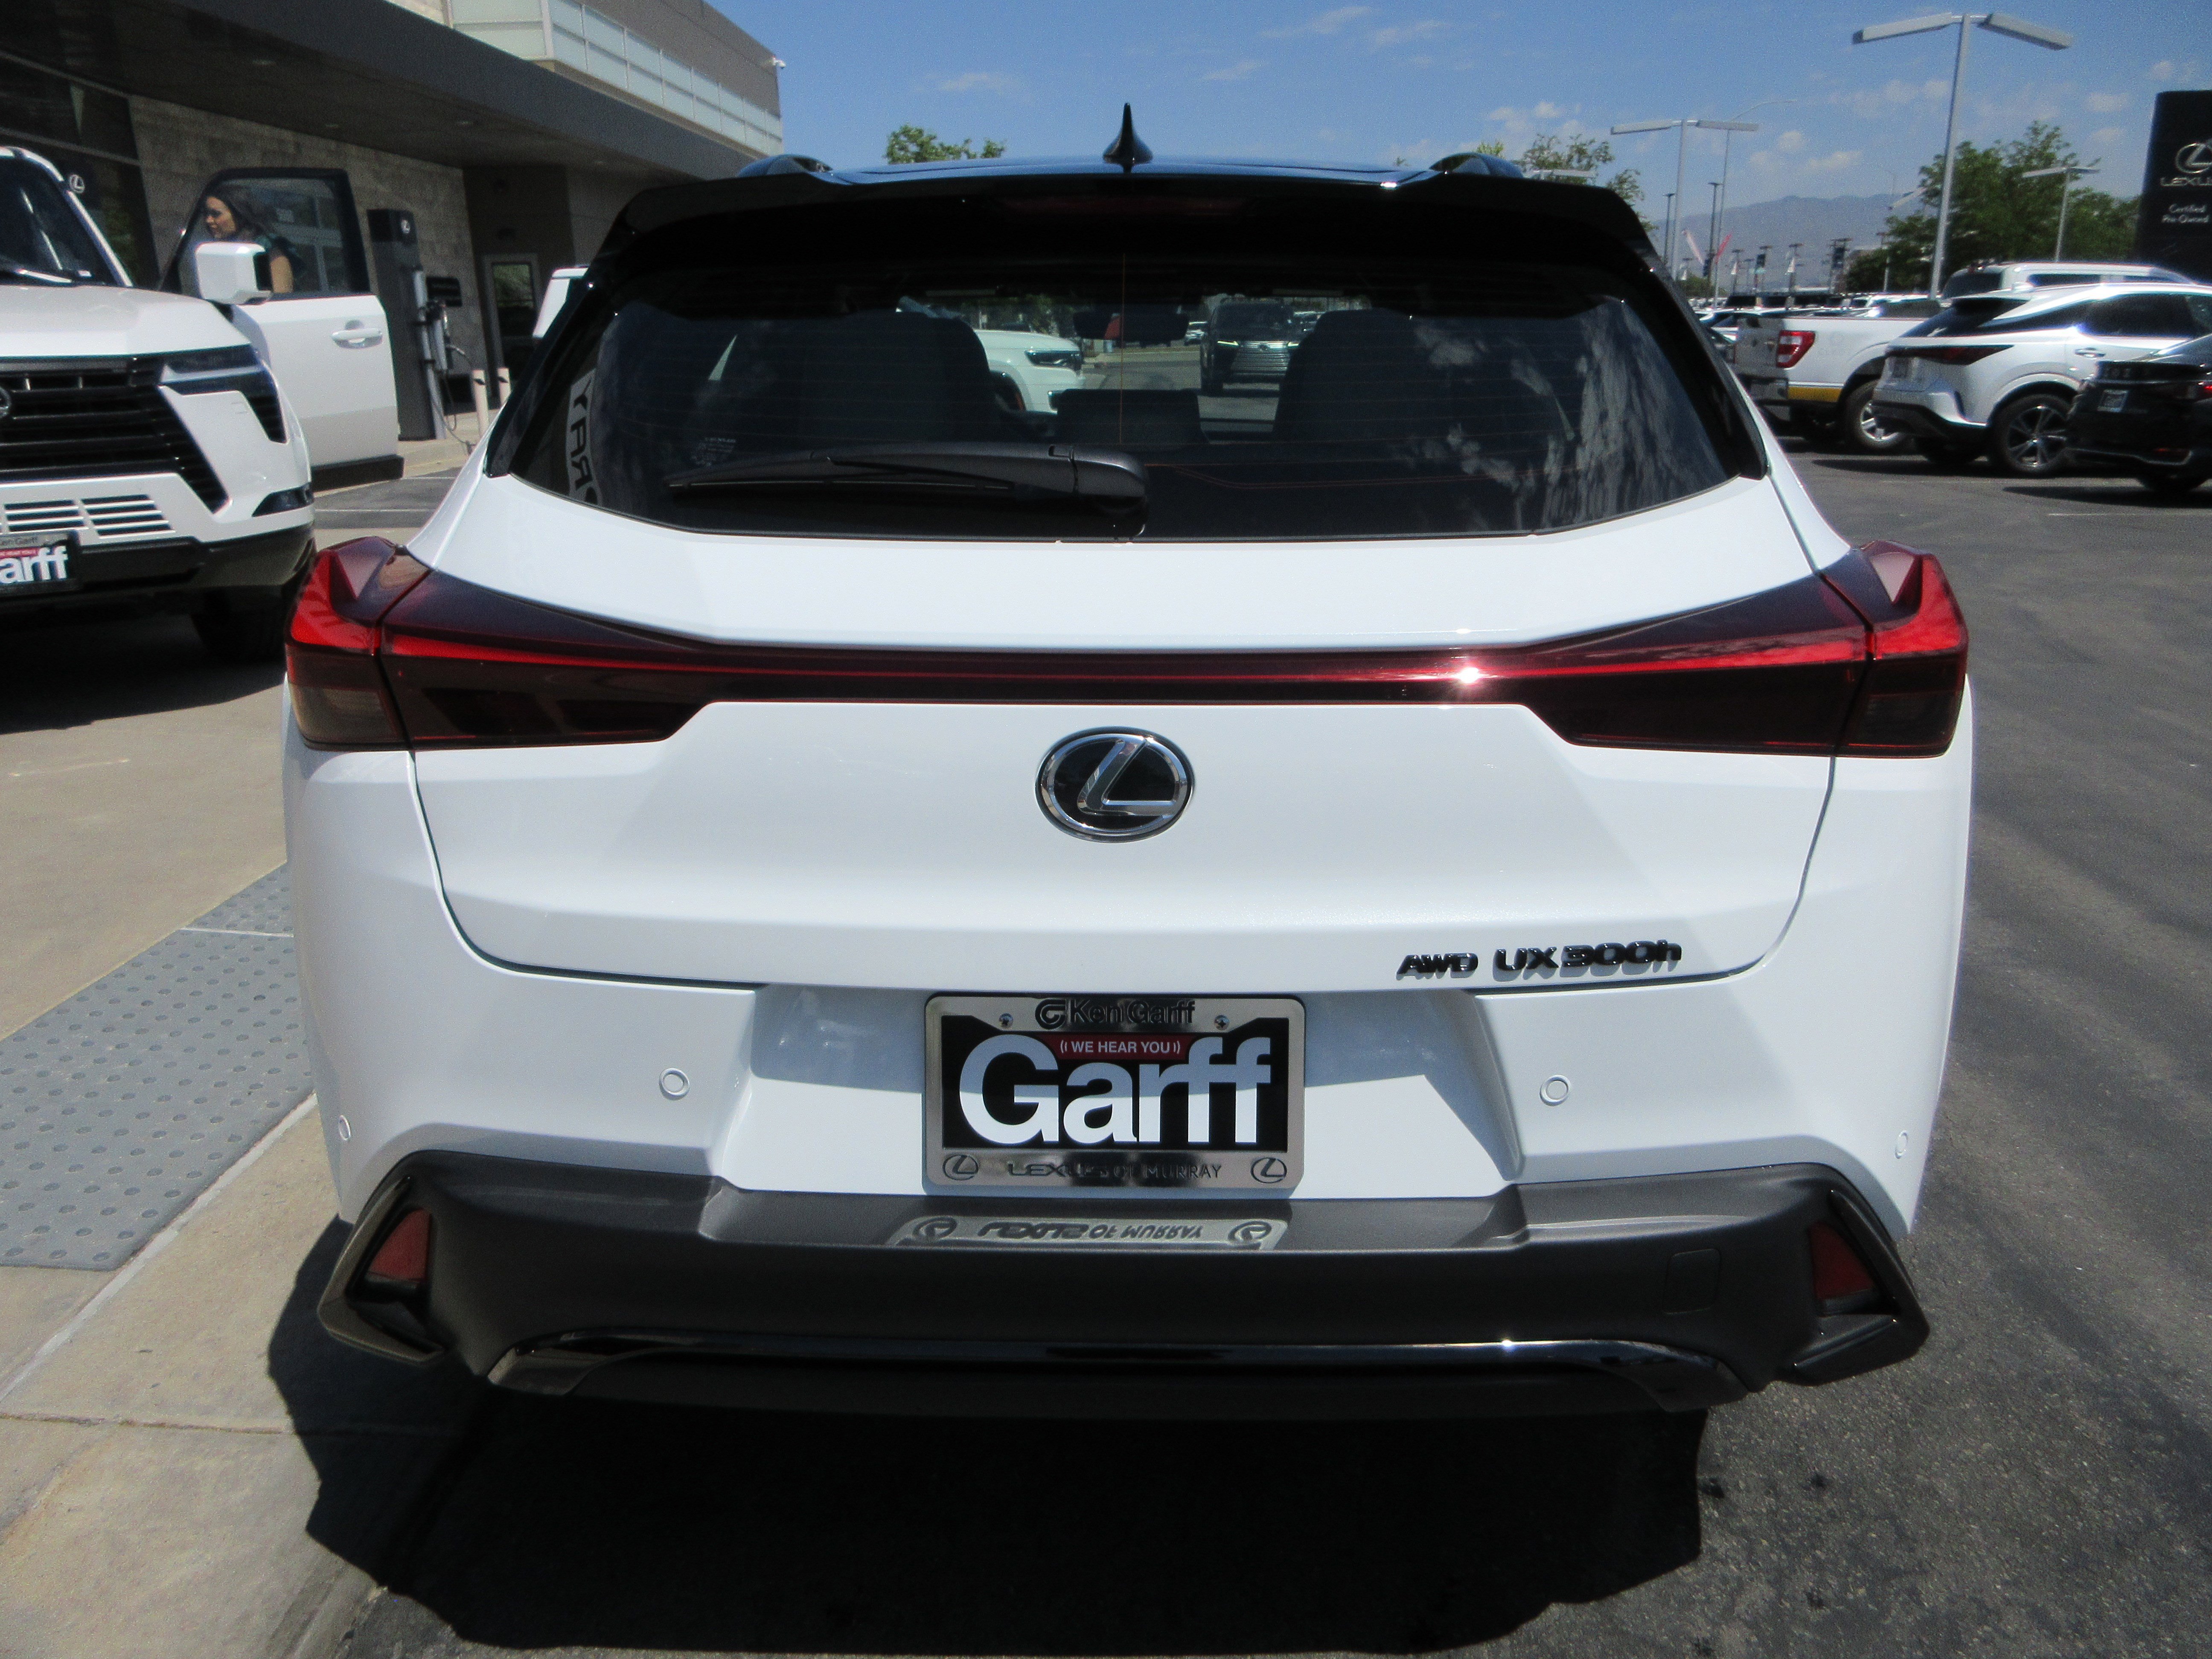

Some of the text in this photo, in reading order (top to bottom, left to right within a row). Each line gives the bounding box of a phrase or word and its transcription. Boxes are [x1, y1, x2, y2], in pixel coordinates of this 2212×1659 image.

[2160, 177, 2212, 186] LEXU
[0, 545, 68, 583] arff
[1396, 952, 1479, 976] AWD
[1069, 998, 1195, 1024] Ken Garff
[1071, 1041, 1170, 1054] WE HEAR YOU
[959, 1034, 1271, 1146] Garff
[1007, 1163, 1109, 1178] LEXUS
[1146, 1164, 1222, 1179] MURRAY
